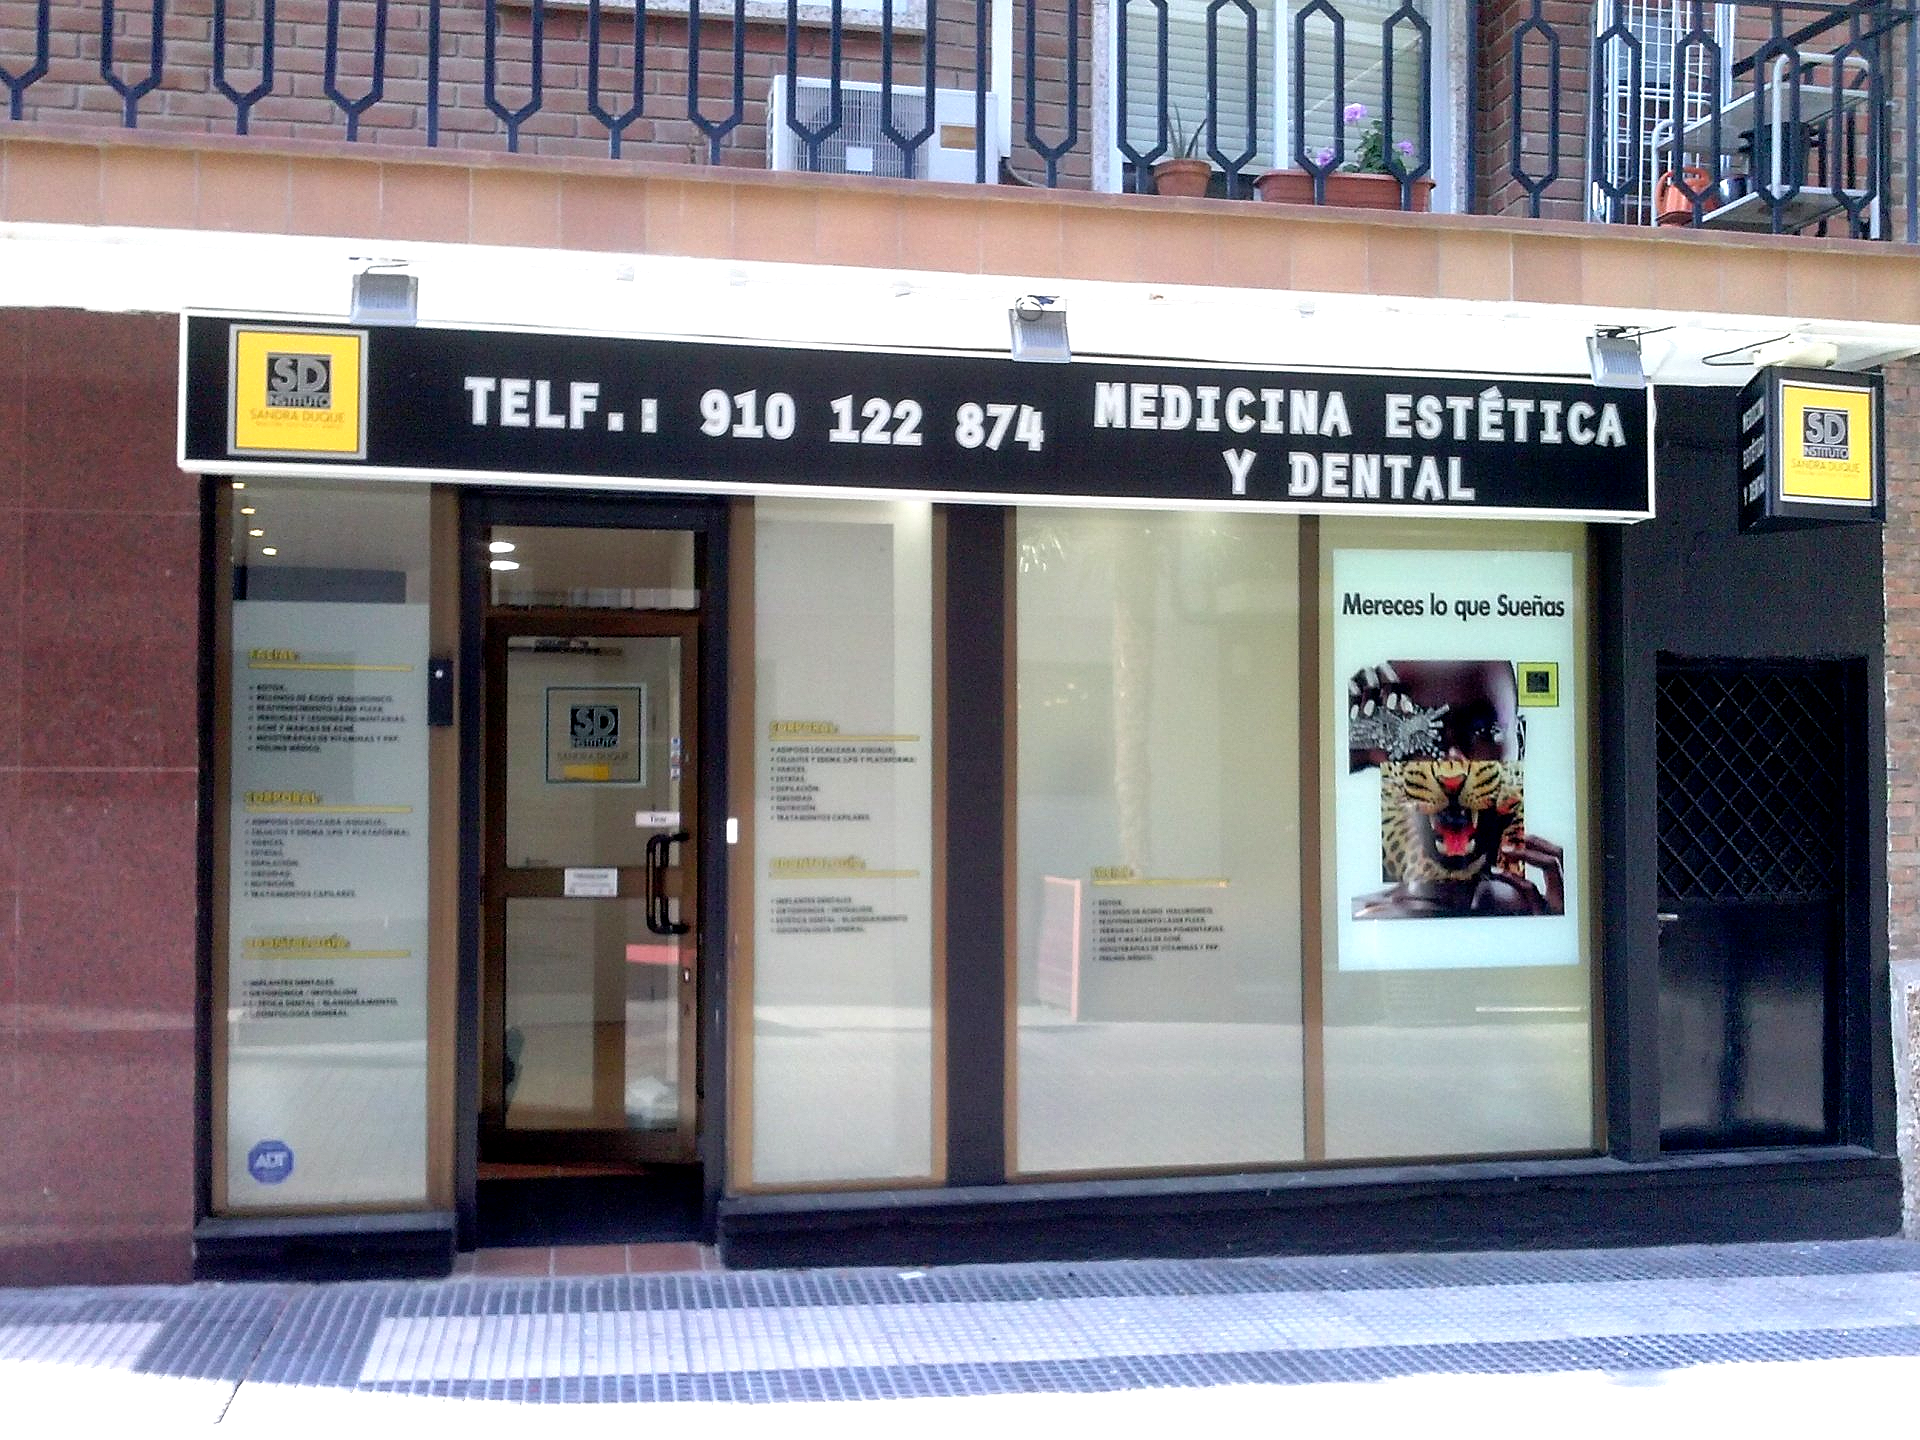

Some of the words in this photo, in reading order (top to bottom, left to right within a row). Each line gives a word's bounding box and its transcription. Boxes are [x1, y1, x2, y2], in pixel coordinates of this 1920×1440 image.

[271, 356, 328, 392] SD
[250, 410, 298, 420] SANDRA
[302, 412, 344, 422] DUQUE
[700, 388, 796, 440] 910
[828, 394, 923, 447] 122
[954, 402, 1045, 452] 874
[1093, 381, 1353, 437] MEDICINA
[1385, 386, 1626, 447] ESTÉTICA
[1805, 412, 1845, 445] SD
[1222, 448, 1257, 495] Y
[1287, 451, 1476, 501] DENTAL
[1791, 459, 1826, 470] SANDRA
[1829, 462, 1861, 474] DUQUE
[1342, 592, 1424, 616] Mereces
[1430, 592, 1448, 616] lo
[1454, 600, 1490, 622] que
[1497, 594, 1565, 617] Sueñas
[574, 707, 615, 737] SD
